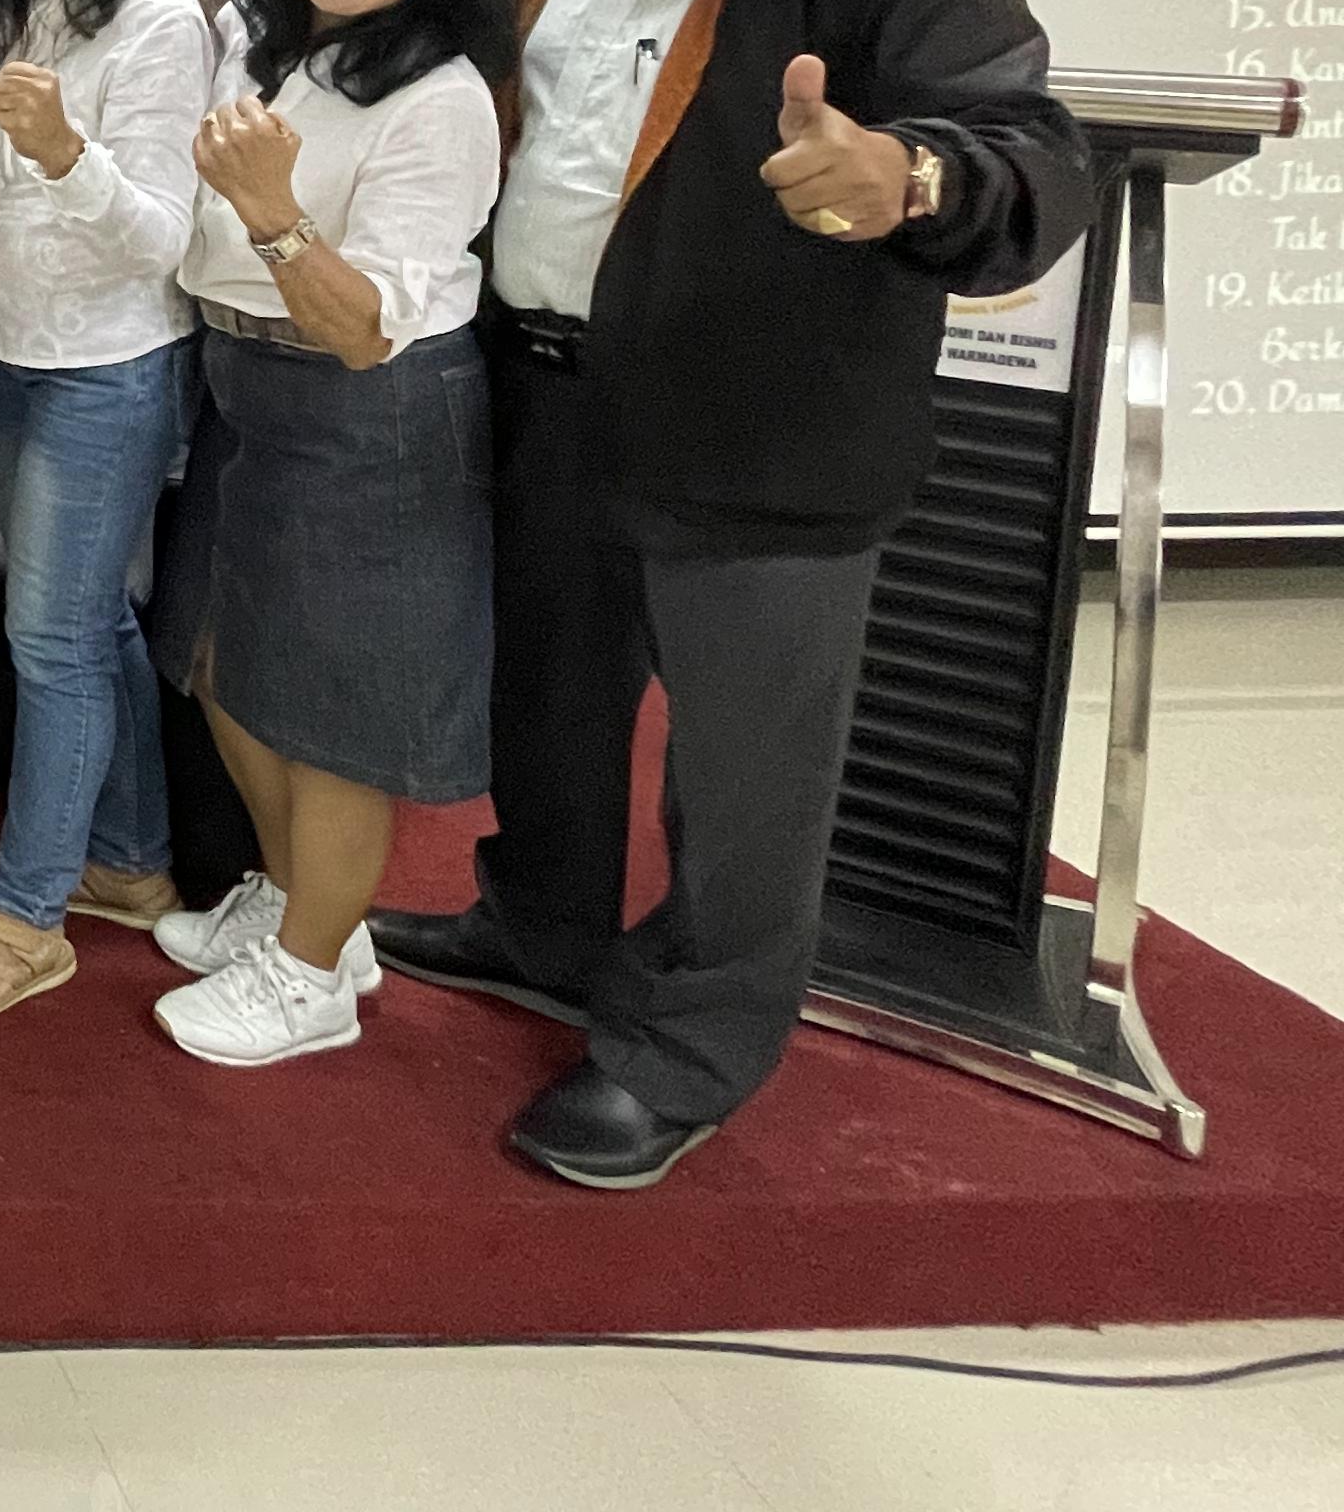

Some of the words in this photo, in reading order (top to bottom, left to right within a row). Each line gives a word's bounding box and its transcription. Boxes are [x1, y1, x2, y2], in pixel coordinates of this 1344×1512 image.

[1269, 160, 1344, 201] Jika
[1270, 216, 1327, 251] Tak
[1206, 272, 1253, 310] 19.
[1191, 379, 1256, 415] 20.
